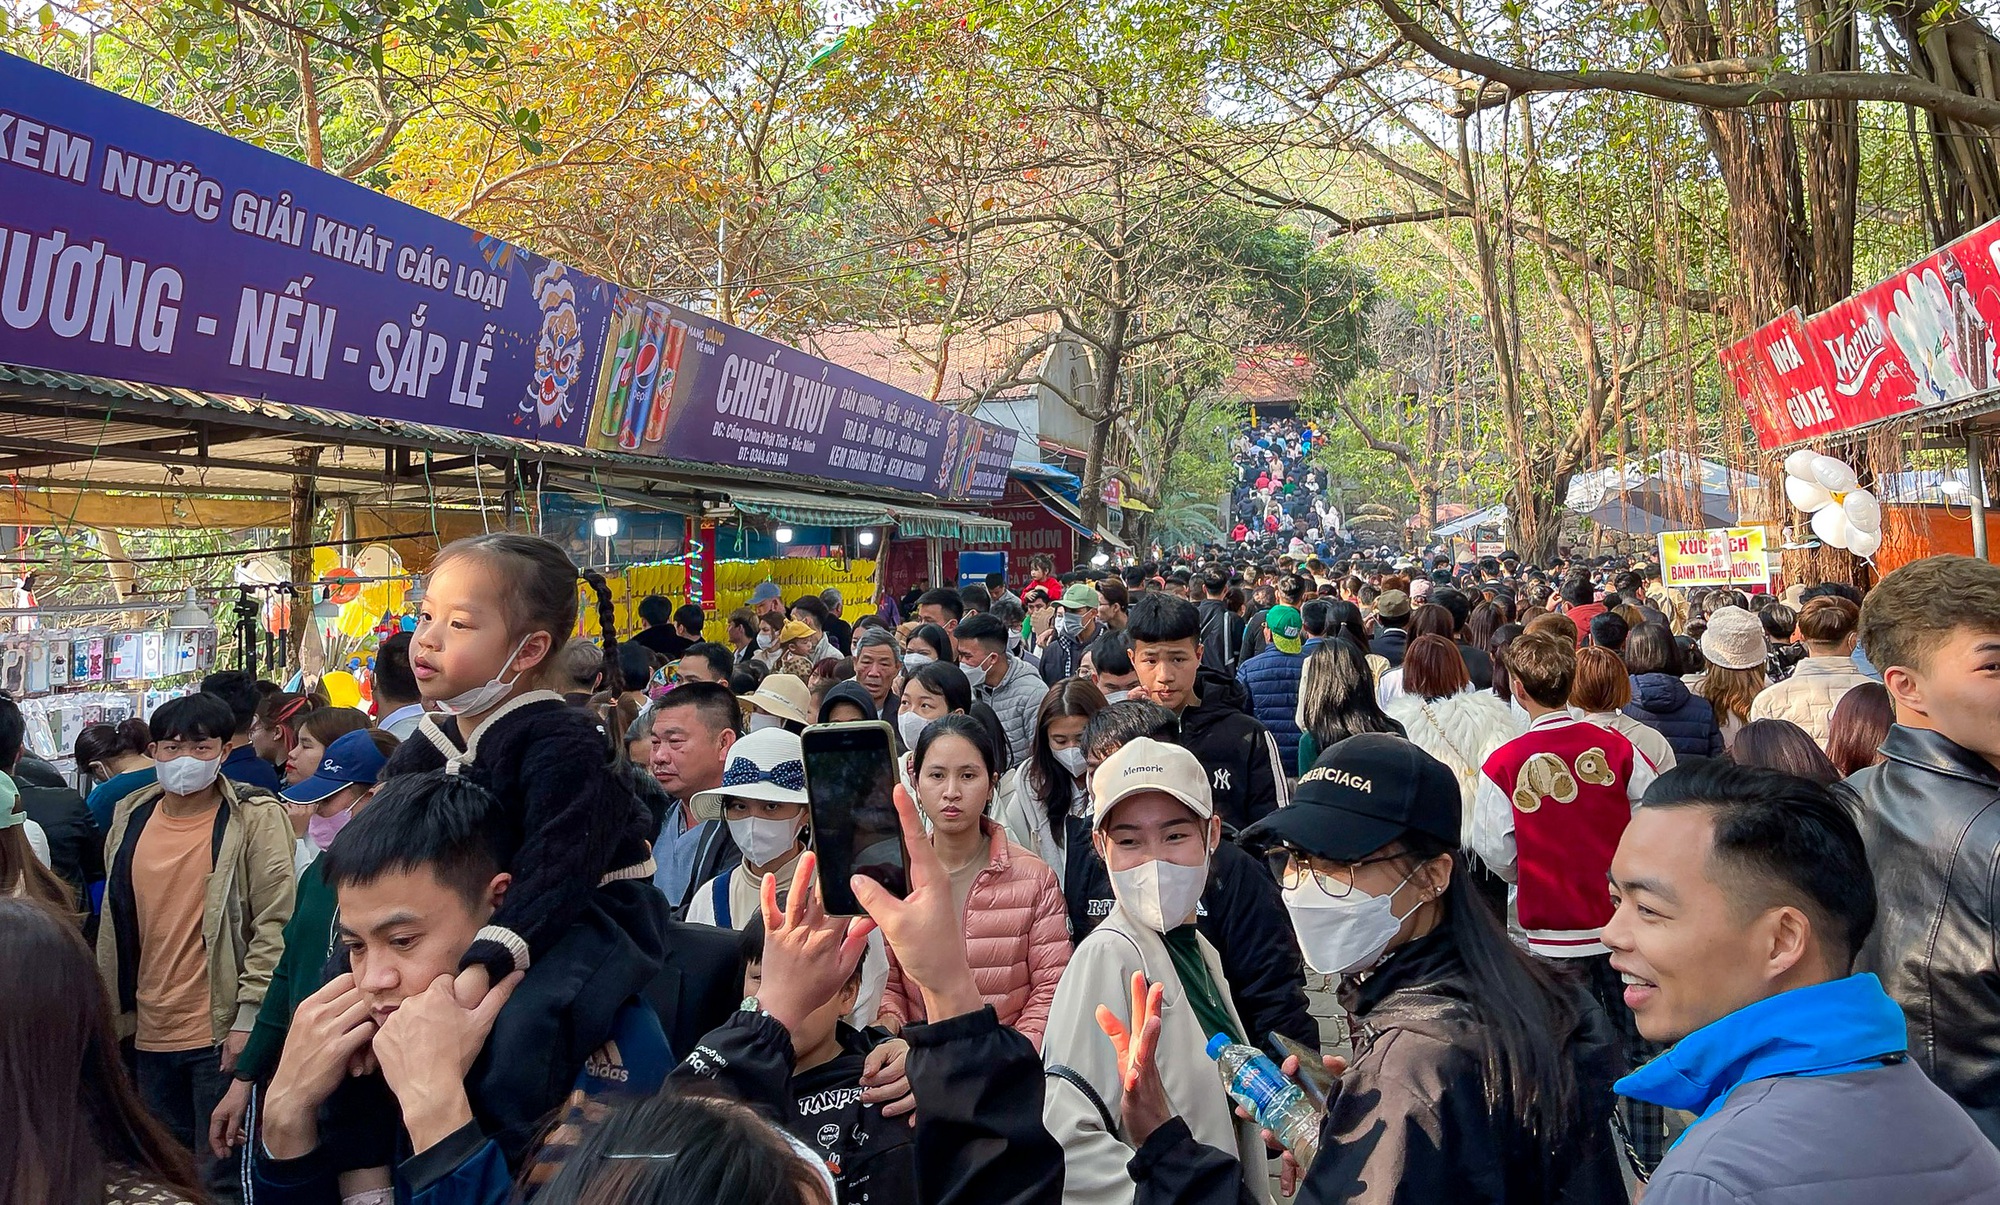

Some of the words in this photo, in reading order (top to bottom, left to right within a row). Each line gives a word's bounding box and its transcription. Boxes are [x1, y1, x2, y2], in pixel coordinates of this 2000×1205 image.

[102, 148, 222, 220] NƯỚC
[232, 193, 306, 247] GIẢI
[311, 216, 393, 272] KHÁT
[397, 246, 450, 290] CÁC
[454, 264, 508, 311] LOẠI
[0, 227, 184, 354] ƯƠNG
[229, 276, 337, 381] NẾN
[369, 303, 448, 399] SẮP
[449, 323, 497, 409] LỄ
[1767, 328, 1804, 376] NHÀ
[1823, 316, 1883, 383] Merino
[716, 349, 789, 426] CHIẾN
[1806, 385, 1836, 423] XE
[839, 385, 858, 411] BÁN
[856, 390, 882, 415] HƯƠNG
[925, 417, 943, 438] CAFE
[828, 445, 847, 468] KEM
[1011, 527, 1062, 550] THƠM
[1671, 563, 1695, 580] BÁNH
[1123, 764, 1164, 777] Memorie
[1213, 768, 1231, 790] NY
